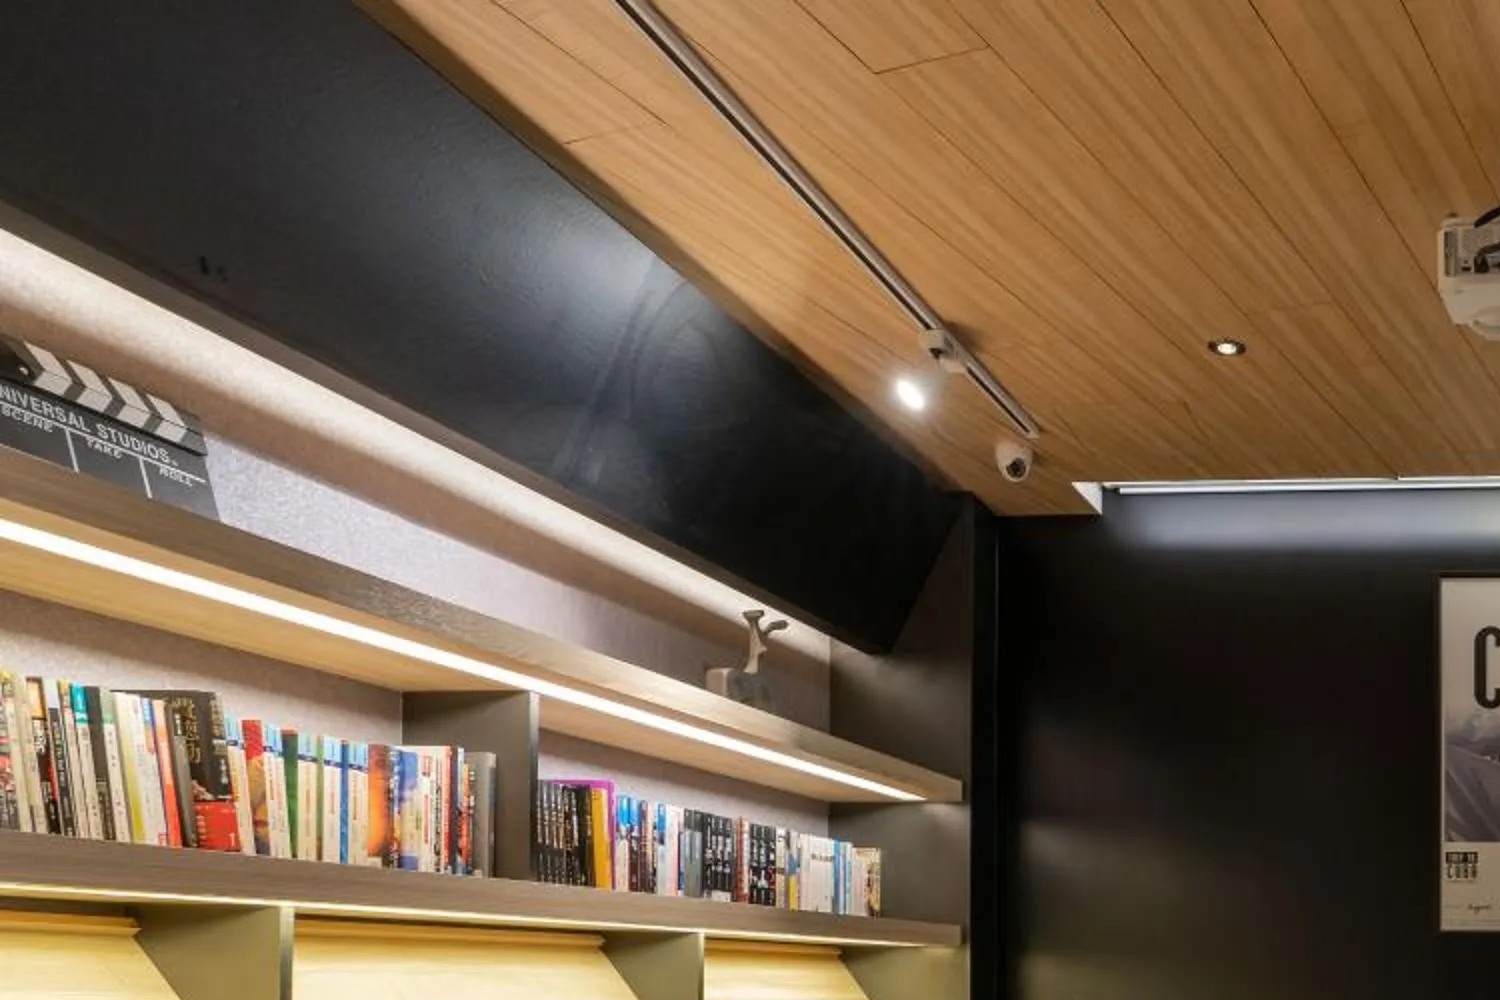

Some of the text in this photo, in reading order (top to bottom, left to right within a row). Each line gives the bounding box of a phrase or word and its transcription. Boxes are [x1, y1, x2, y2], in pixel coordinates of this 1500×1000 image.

[0, 384, 169, 463] NIVERSAL STUDIOS
[1, 402, 53, 433] SCENE
[87, 436, 123, 460] TAKE
